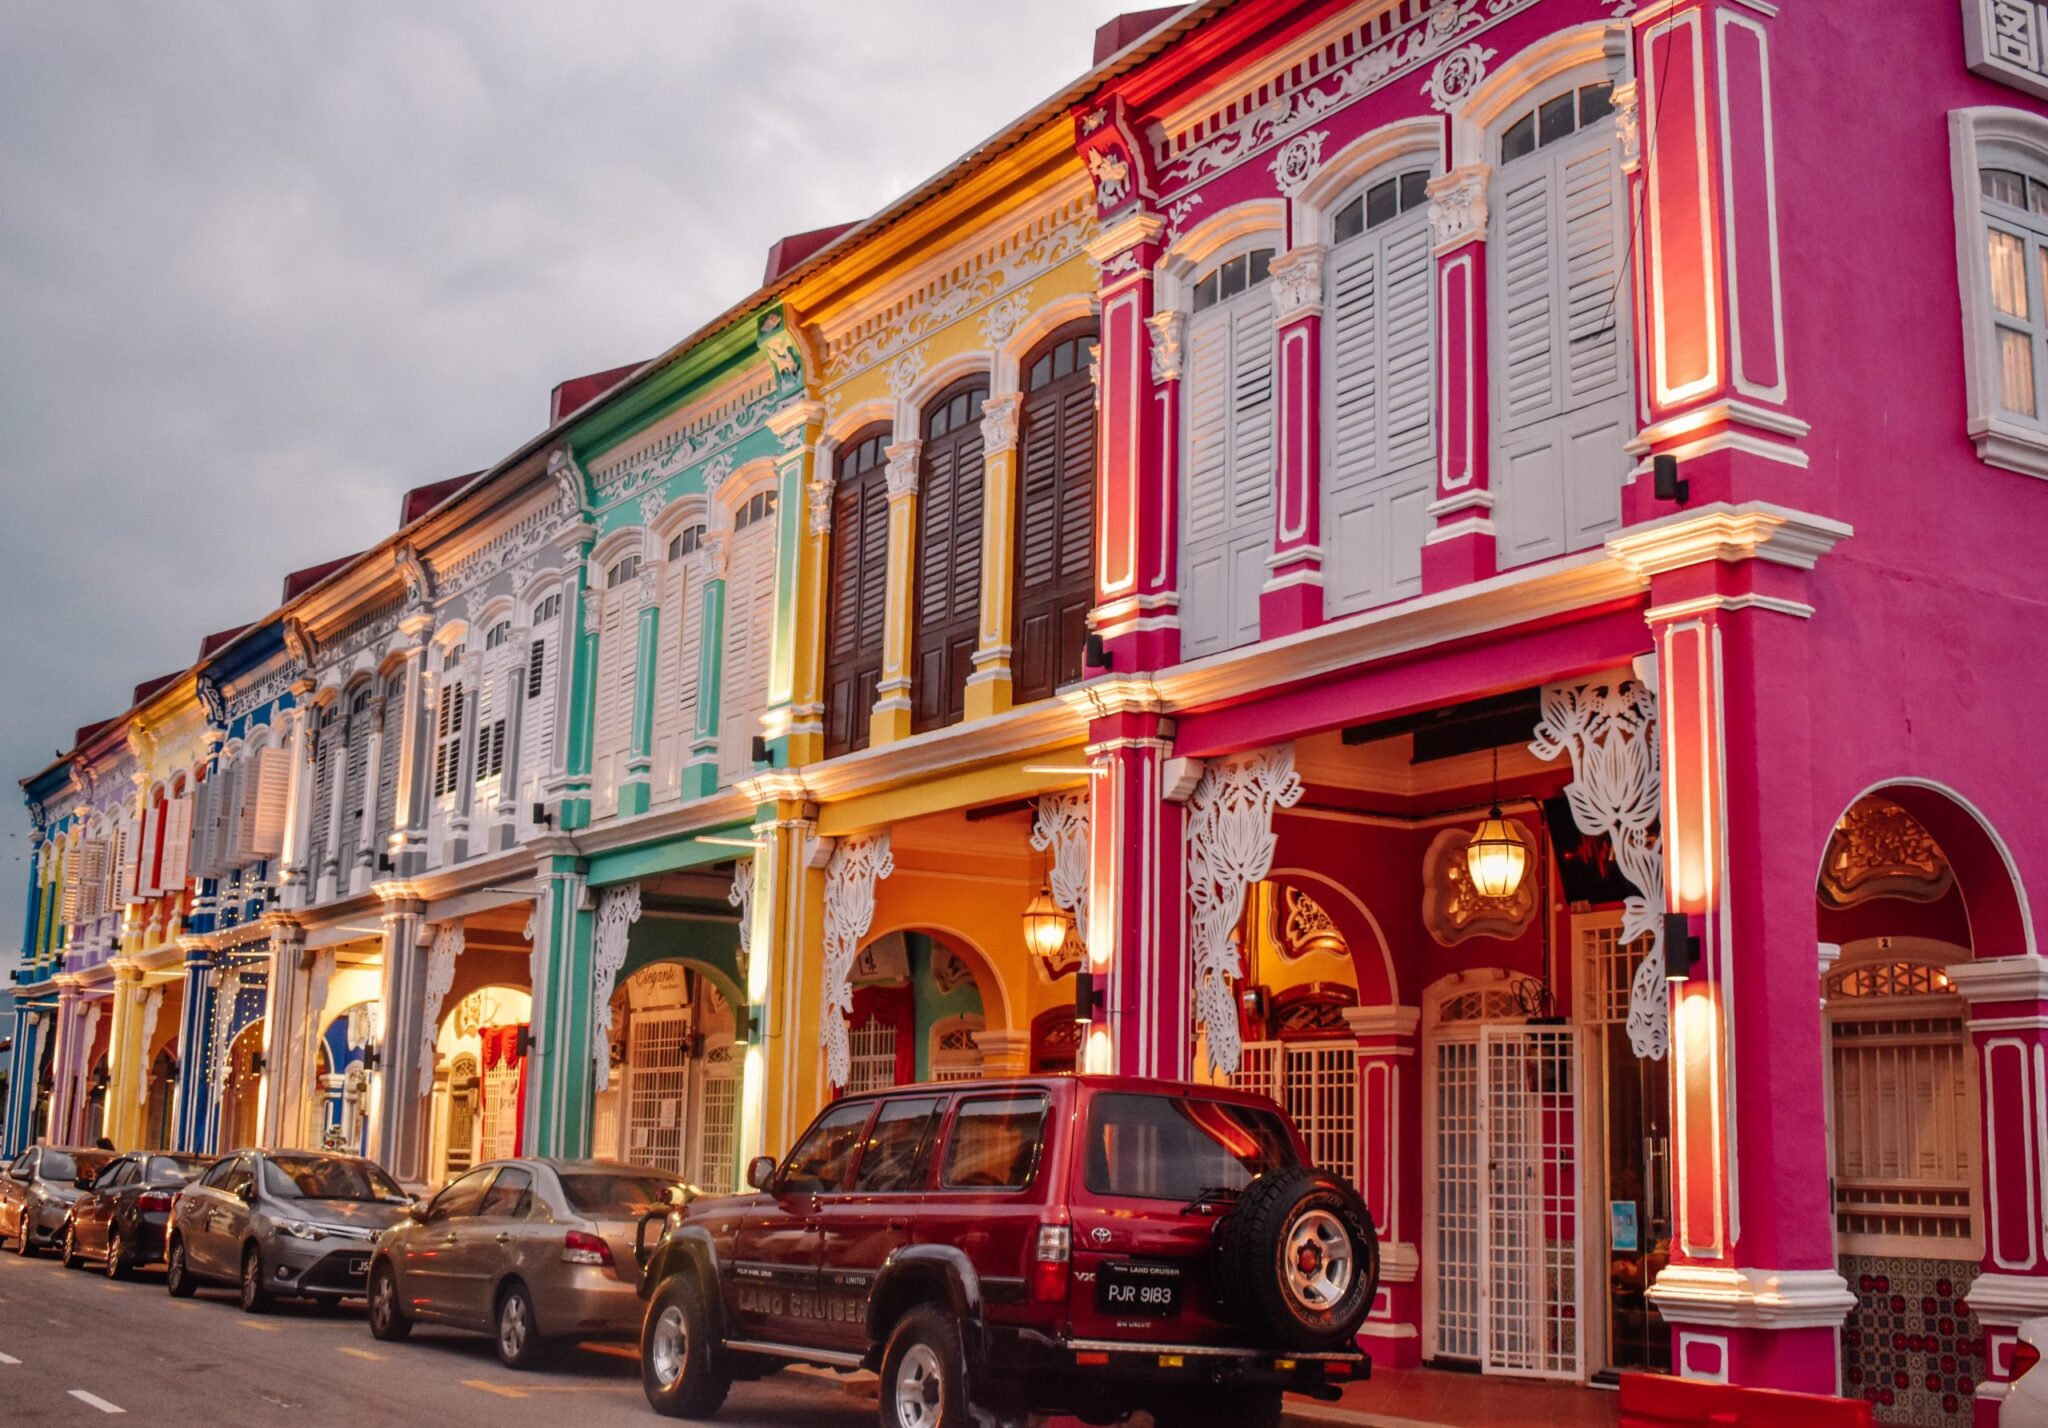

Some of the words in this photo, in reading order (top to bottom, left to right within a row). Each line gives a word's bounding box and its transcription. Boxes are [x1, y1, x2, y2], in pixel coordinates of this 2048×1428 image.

[1073, 1271, 1096, 1282] VX
[1130, 1266, 1149, 1274] LAND
[1150, 1268, 1180, 1276] CRUISER
[845, 1275, 866, 1286] LIMITED
[1108, 1285, 1136, 1302] PJR
[1140, 1286, 1172, 1304] 9183
[738, 1289, 784, 1315] LAND
[789, 1292, 867, 1323] CRUISER
